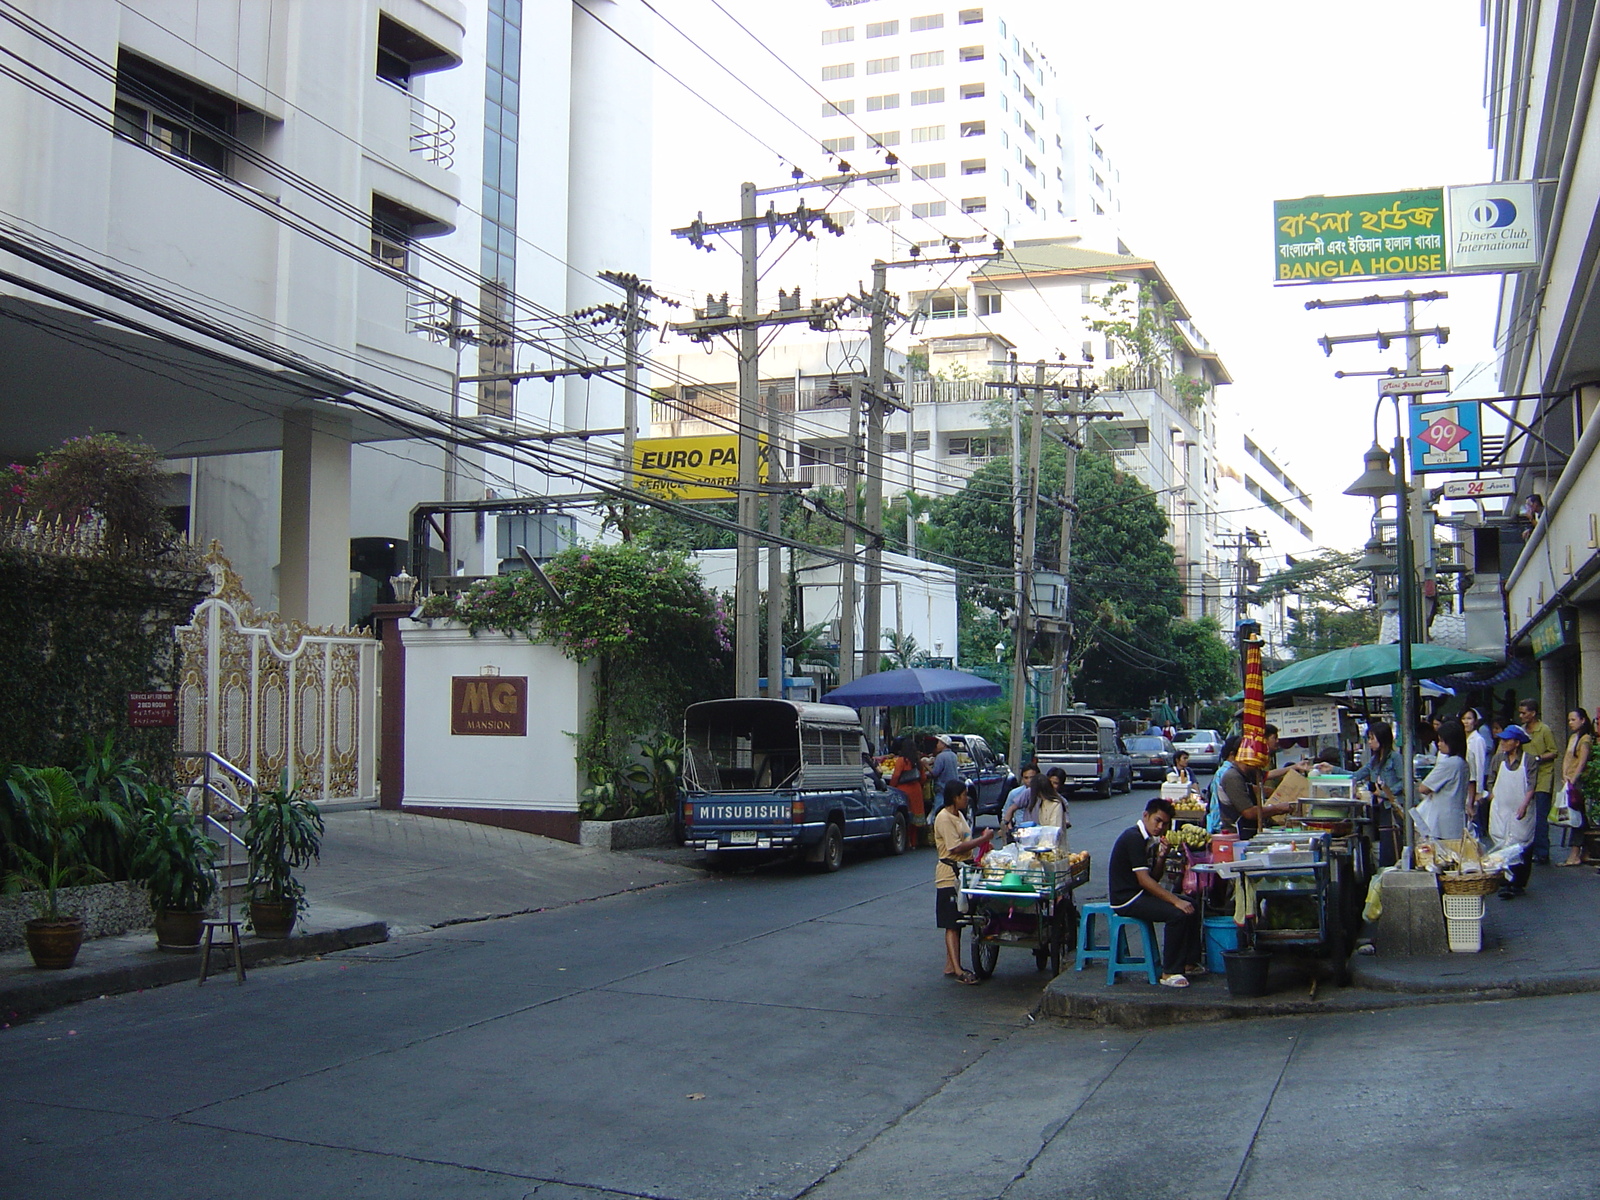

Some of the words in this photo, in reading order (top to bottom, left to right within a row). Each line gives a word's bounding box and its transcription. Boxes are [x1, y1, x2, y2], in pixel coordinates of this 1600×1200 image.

[1278, 210, 1353, 238] বাংলা
[1360, 200, 1439, 233] হাউজ
[1459, 231, 1497, 242] Diners
[1500, 228, 1528, 239] Club
[1279, 239, 1325, 258] বাংলাদেশী
[1327, 238, 1347, 256] এবং
[1384, 236, 1411, 253] হালাল
[1415, 234, 1441, 250] খাবার
[1456, 238, 1530, 253] International
[1279, 259, 1364, 279] BANGLA
[1371, 254, 1441, 274] HOUSE
[1383, 382, 1400, 390] Mini
[1402, 380, 1422, 390] Grand
[1424, 379, 1443, 388] Mart
[1430, 424, 1457, 444] 99
[641, 449, 703, 470] EURO
[708, 445, 769, 466] PAK
[1448, 485, 1465, 493] Open
[1467, 482, 1484, 494] 24
[461, 682, 518, 714] MG
[467, 720, 511, 730] MANSION
[700, 806, 785, 819] MITSUBISHI
